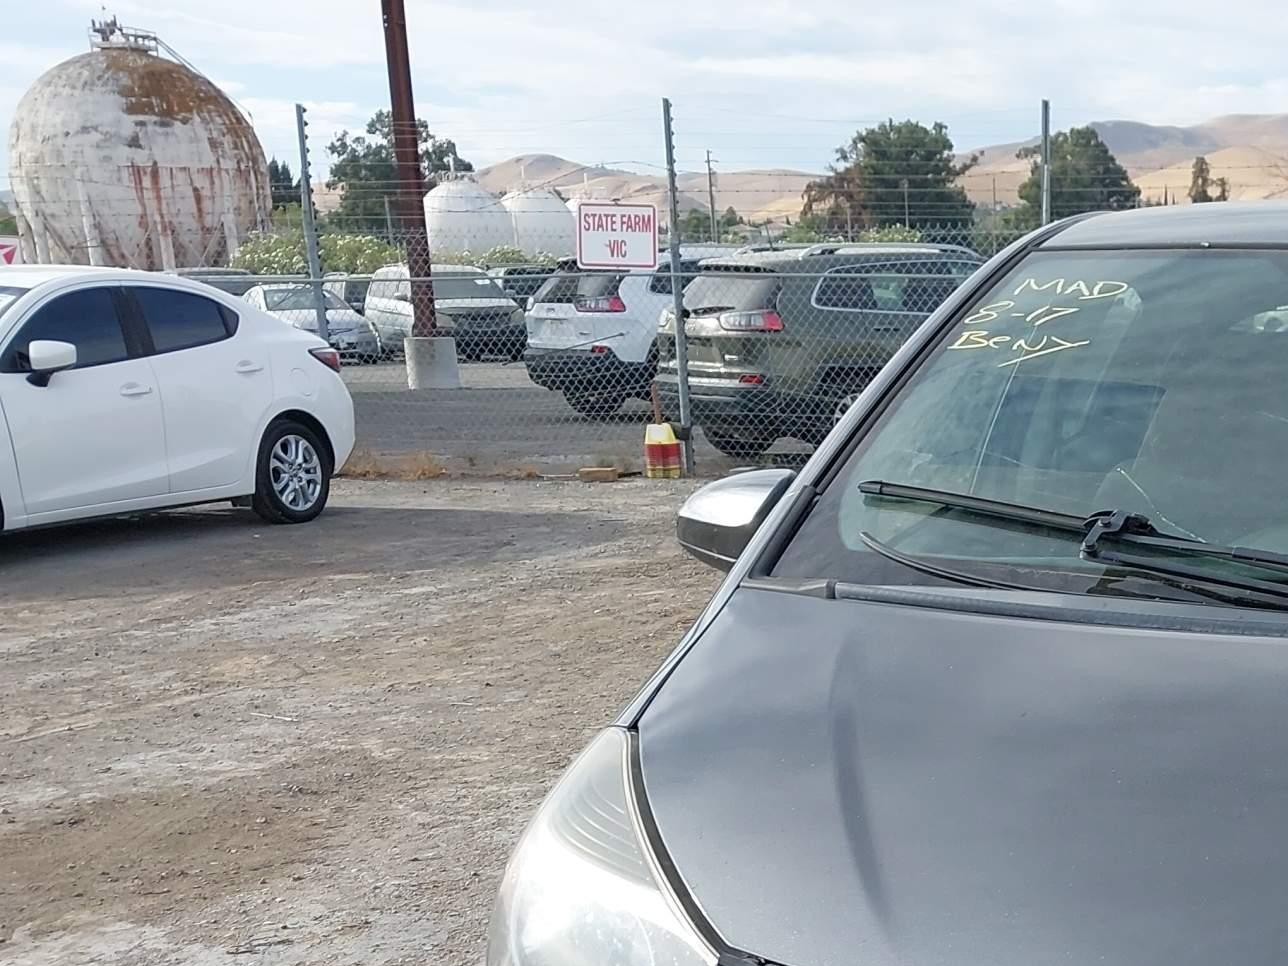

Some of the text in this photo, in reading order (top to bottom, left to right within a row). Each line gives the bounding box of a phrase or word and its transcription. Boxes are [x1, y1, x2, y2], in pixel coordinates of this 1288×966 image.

[583, 213, 652, 233] STATE FARM
[607, 239, 627, 258] VIC
[1014, 278, 1128, 300] MAD
[964, 301, 1080, 326] 8-17
